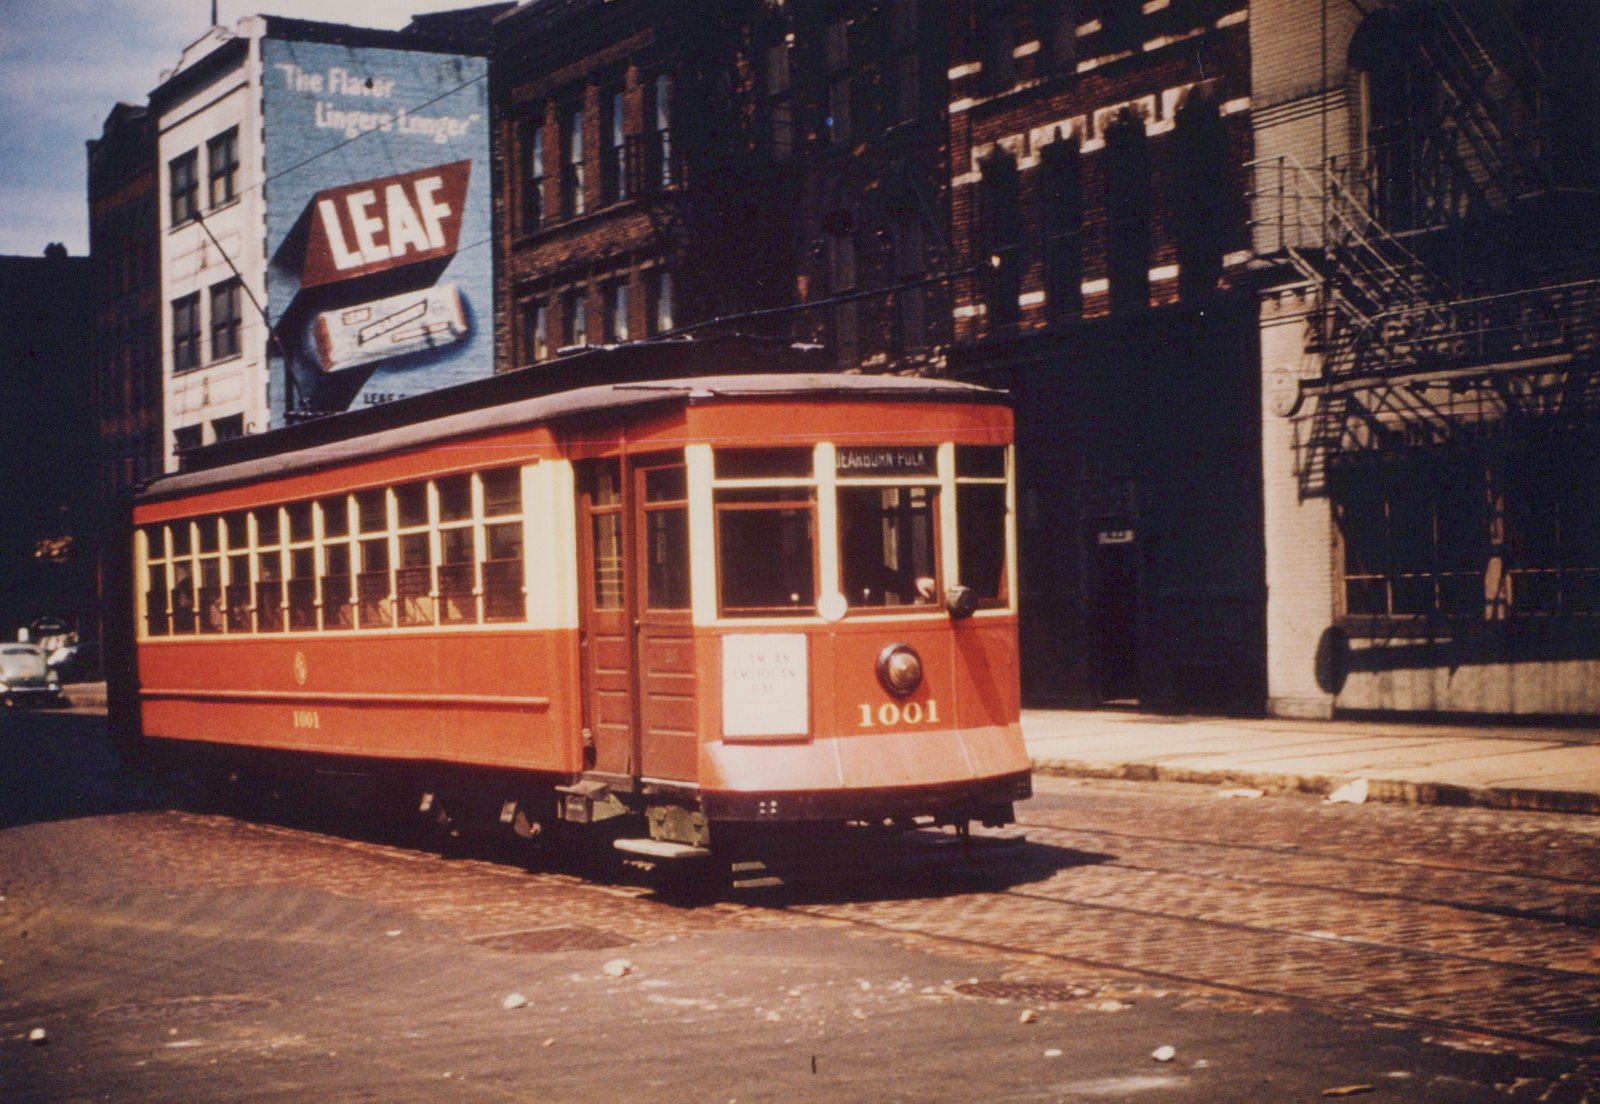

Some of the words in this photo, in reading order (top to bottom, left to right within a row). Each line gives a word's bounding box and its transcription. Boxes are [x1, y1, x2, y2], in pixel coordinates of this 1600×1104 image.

[315, 101, 392, 138] Lingers
[318, 176, 452, 271] LEAF
[293, 710, 319, 729] 1001
[858, 700, 940, 727] 1001
